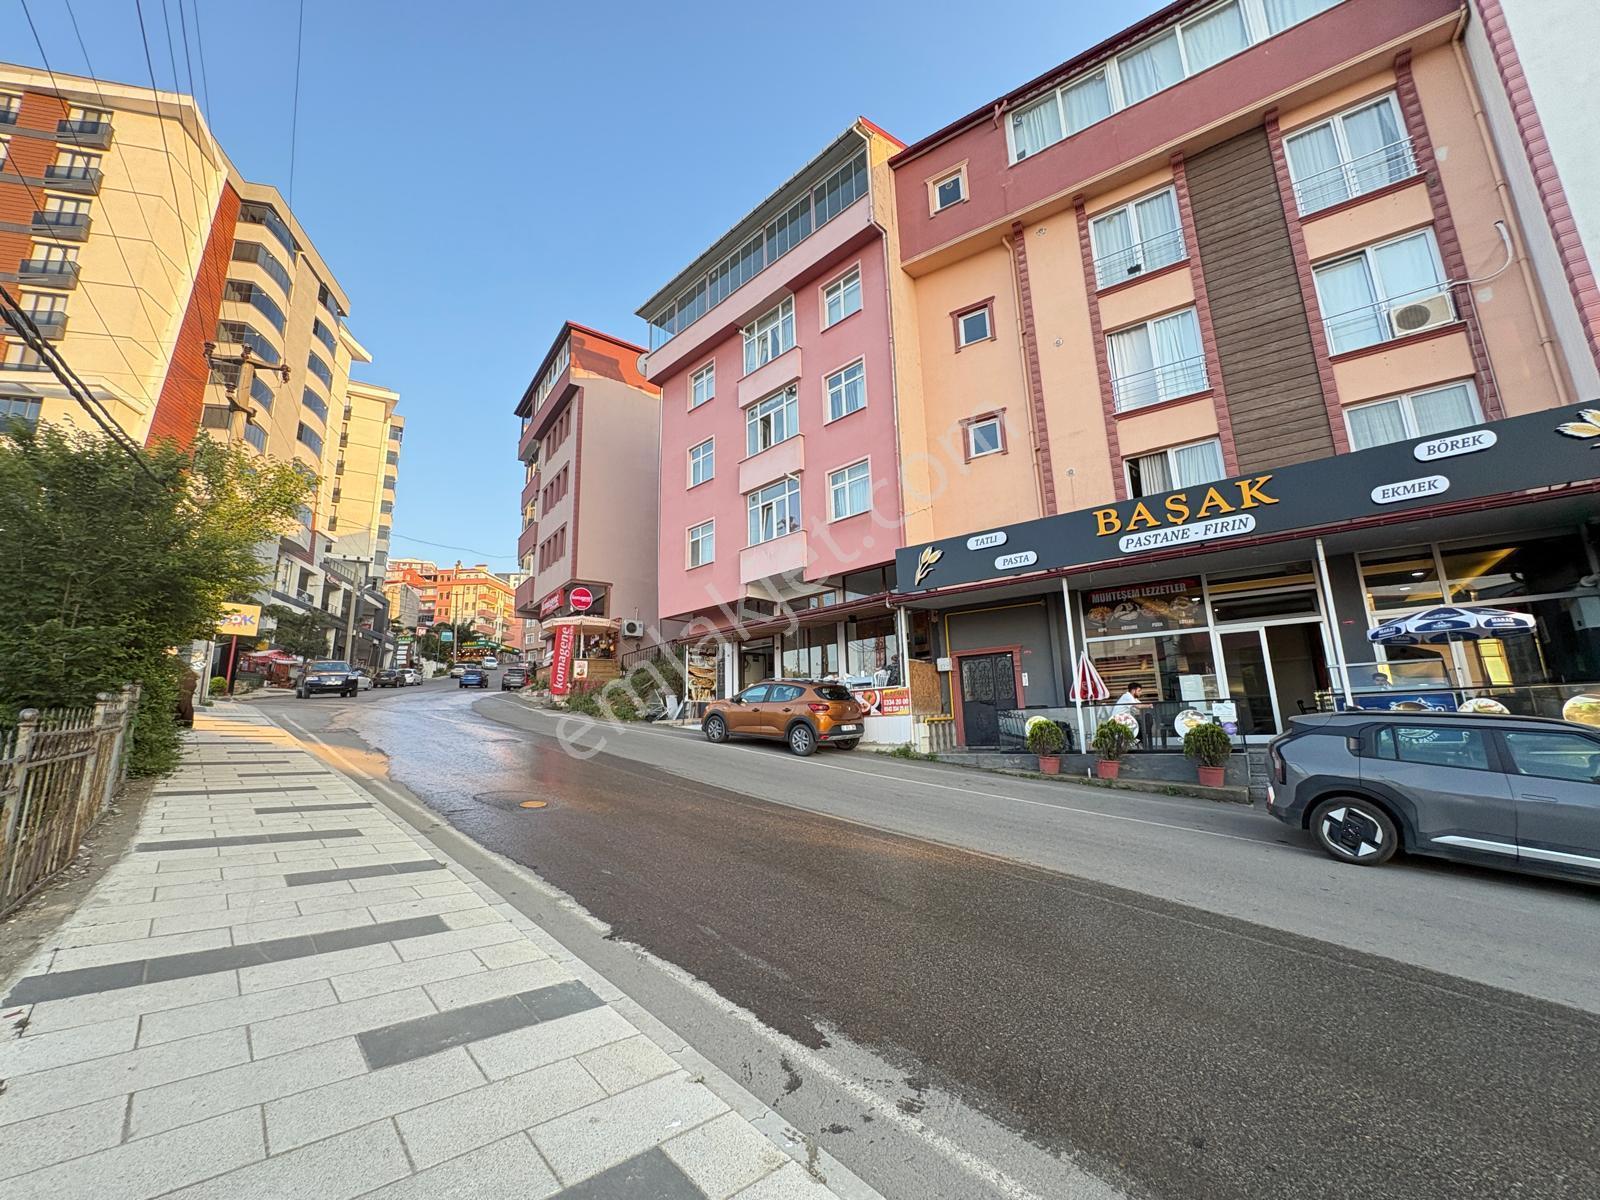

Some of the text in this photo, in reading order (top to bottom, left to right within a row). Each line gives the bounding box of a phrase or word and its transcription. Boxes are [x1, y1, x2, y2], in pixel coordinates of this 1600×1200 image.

[1426, 434, 1484, 456] BÖREK
[1381, 479, 1439, 499] EKMEK
[1092, 475, 1280, 536] BAŞAK
[974, 535, 997, 546] TATLI
[1125, 528, 1190, 549] PASTANE
[1203, 517, 1250, 536] FIRIN
[1002, 554, 1030, 566] PASTA
[1141, 583, 1187, 596] LEZZETLER
[553, 627, 571, 689] komagene
